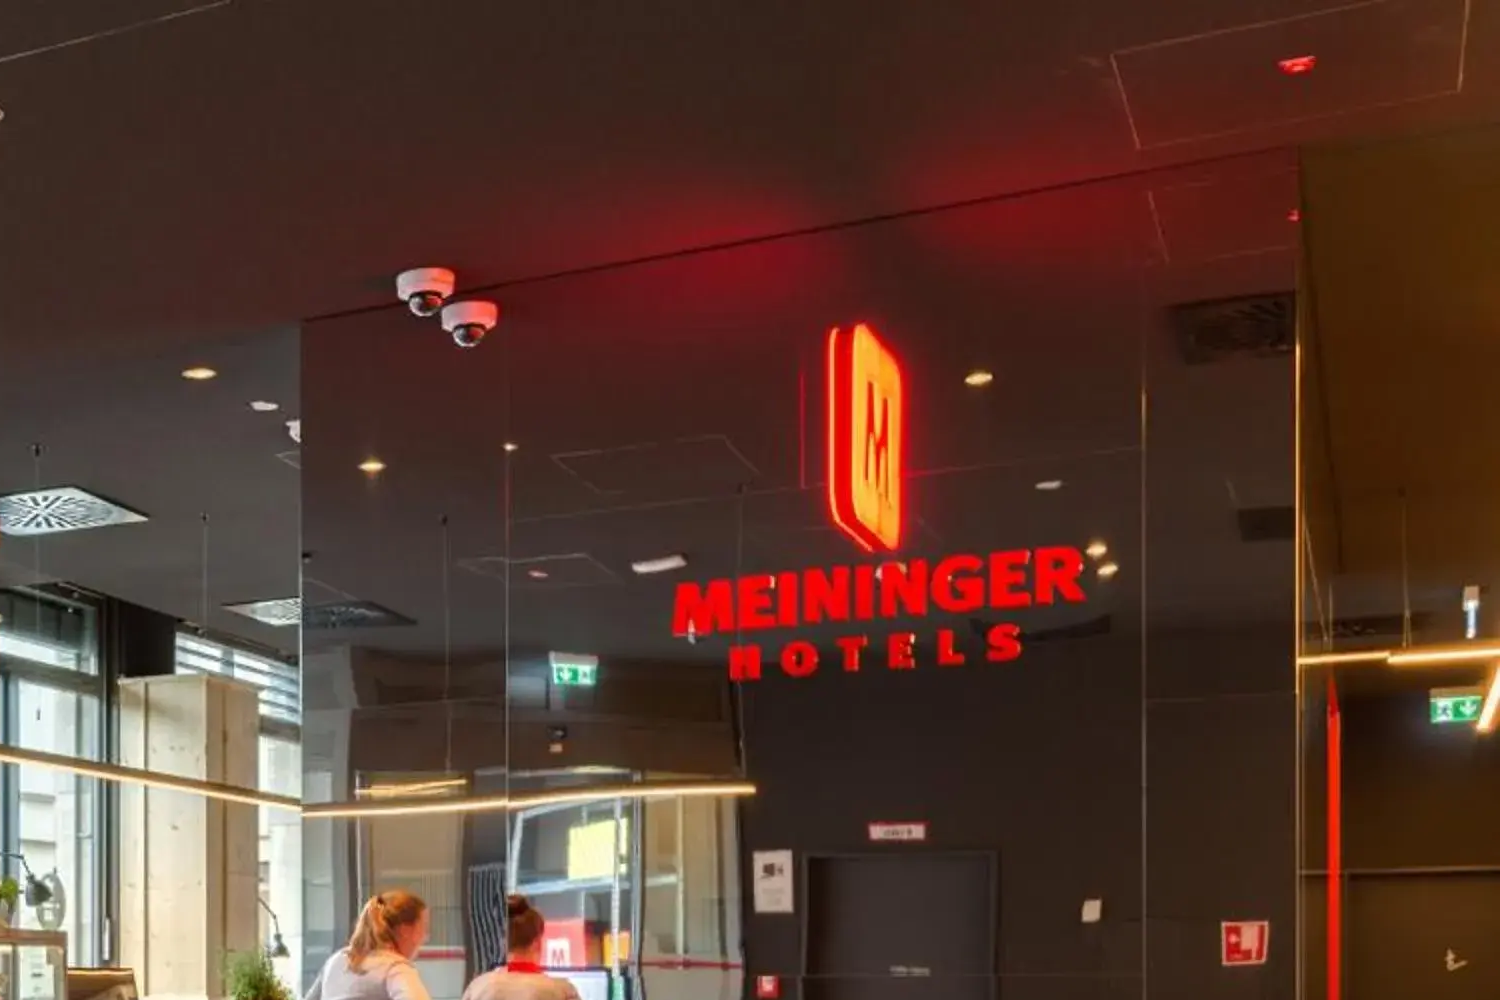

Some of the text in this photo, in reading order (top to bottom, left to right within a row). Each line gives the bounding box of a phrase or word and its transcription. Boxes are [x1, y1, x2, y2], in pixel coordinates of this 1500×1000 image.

[864, 380, 892, 504] M
[673, 546, 1087, 637] MEININGER
[729, 623, 1023, 681] HOTELS
